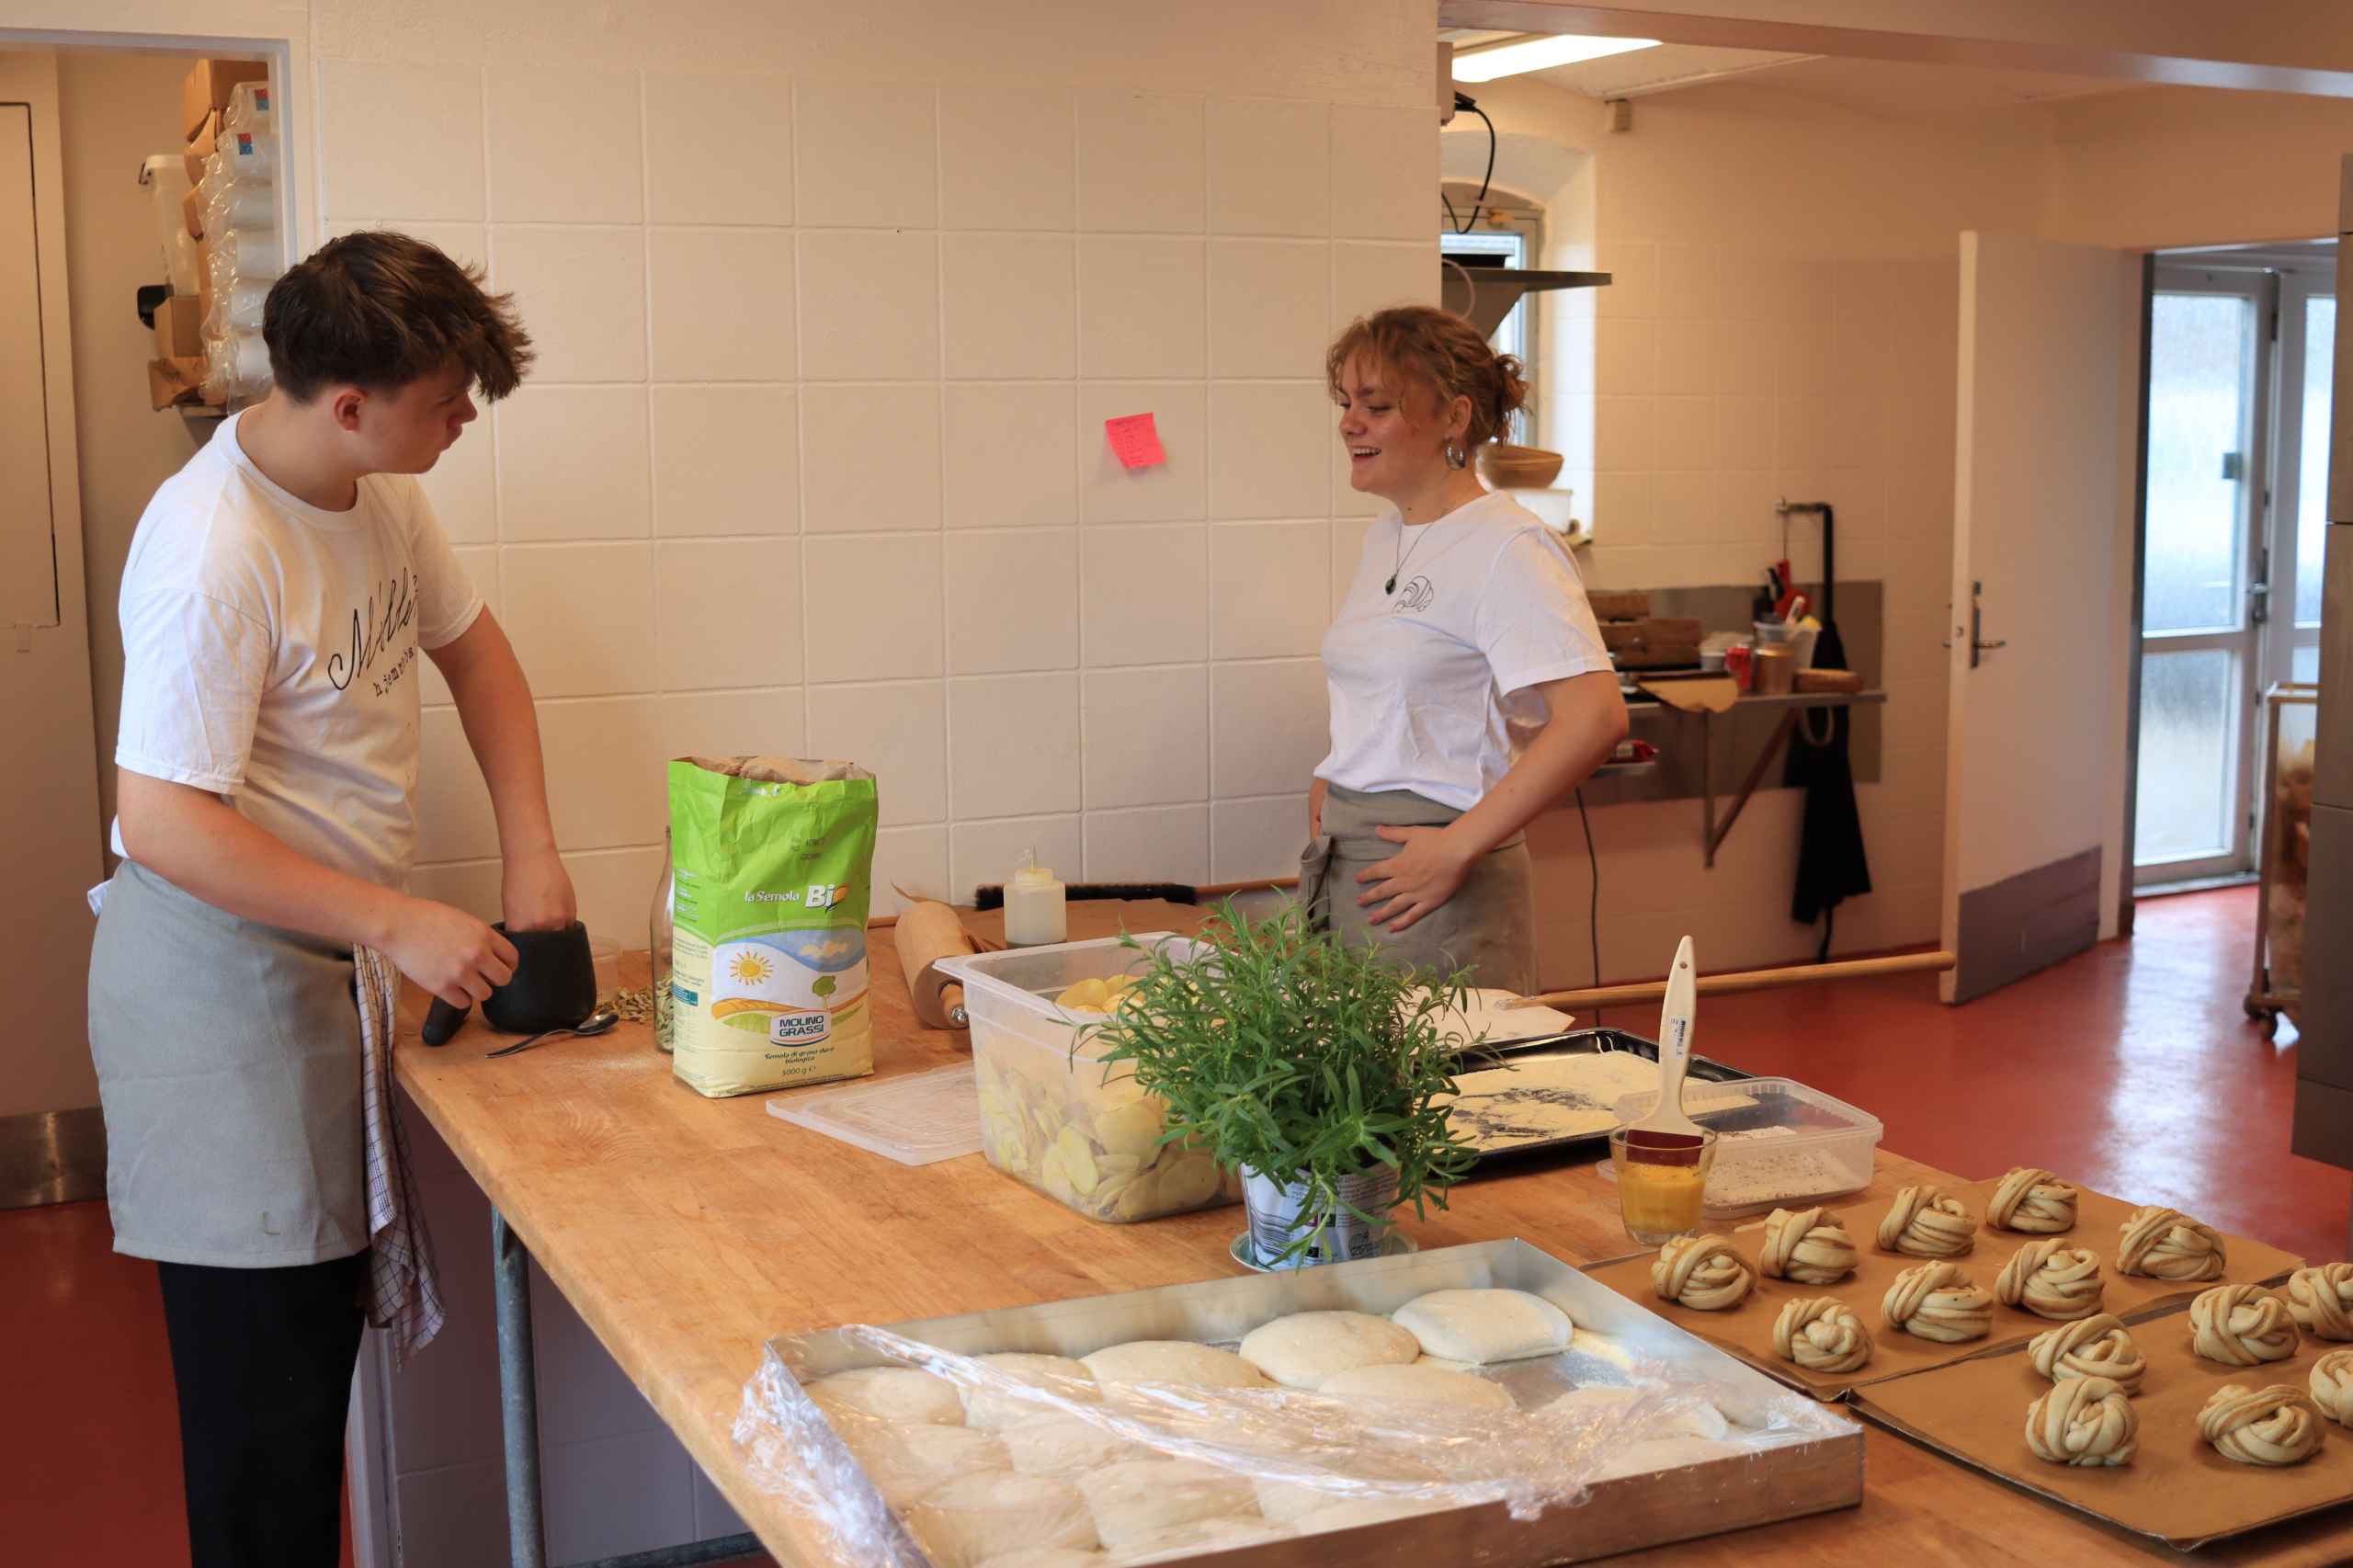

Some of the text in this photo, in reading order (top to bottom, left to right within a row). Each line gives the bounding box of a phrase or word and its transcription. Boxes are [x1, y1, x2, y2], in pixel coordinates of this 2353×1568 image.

[756, 890, 801, 903] Semola
[805, 883, 847, 910] Bio
[779, 1015, 824, 1028] MOLINO
[779, 1025, 824, 1037] GRASSI
